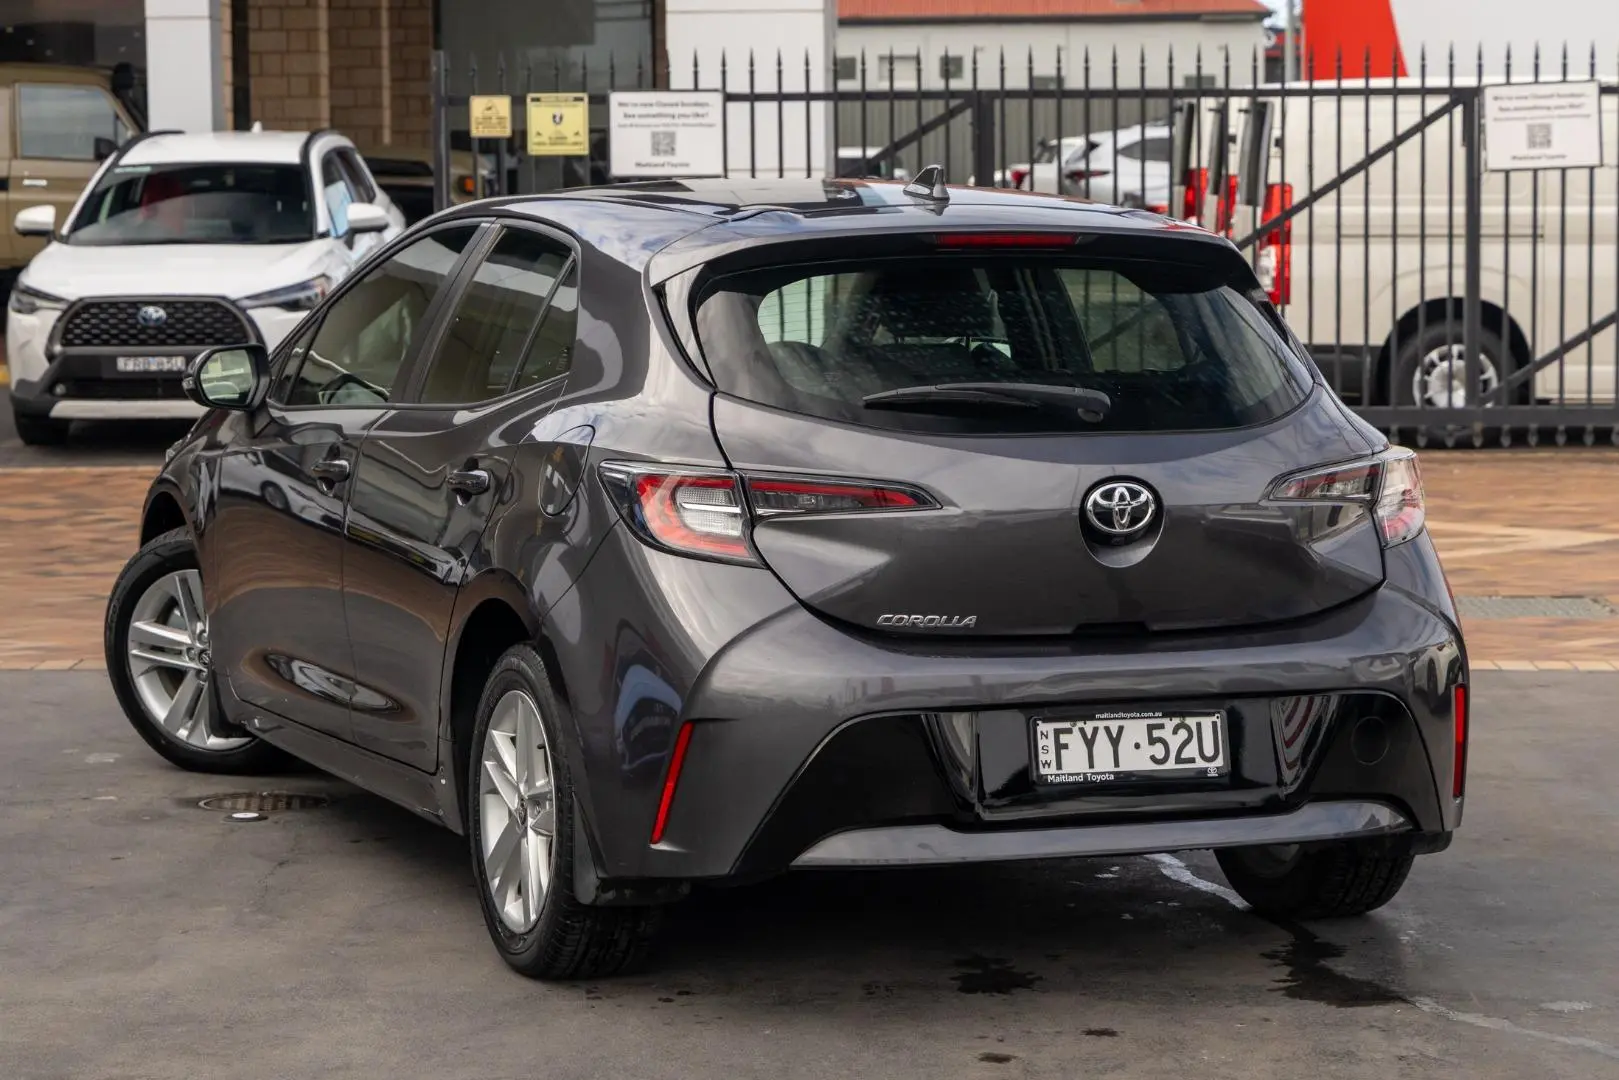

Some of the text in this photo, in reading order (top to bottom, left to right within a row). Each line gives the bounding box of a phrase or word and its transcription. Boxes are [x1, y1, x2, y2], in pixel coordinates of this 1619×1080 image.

[876, 614, 977, 628] COROLLA
[1095, 711, 1163, 719] maitlandtoyota.com.au
[1047, 773, 1115, 783] Maitland Toyota
